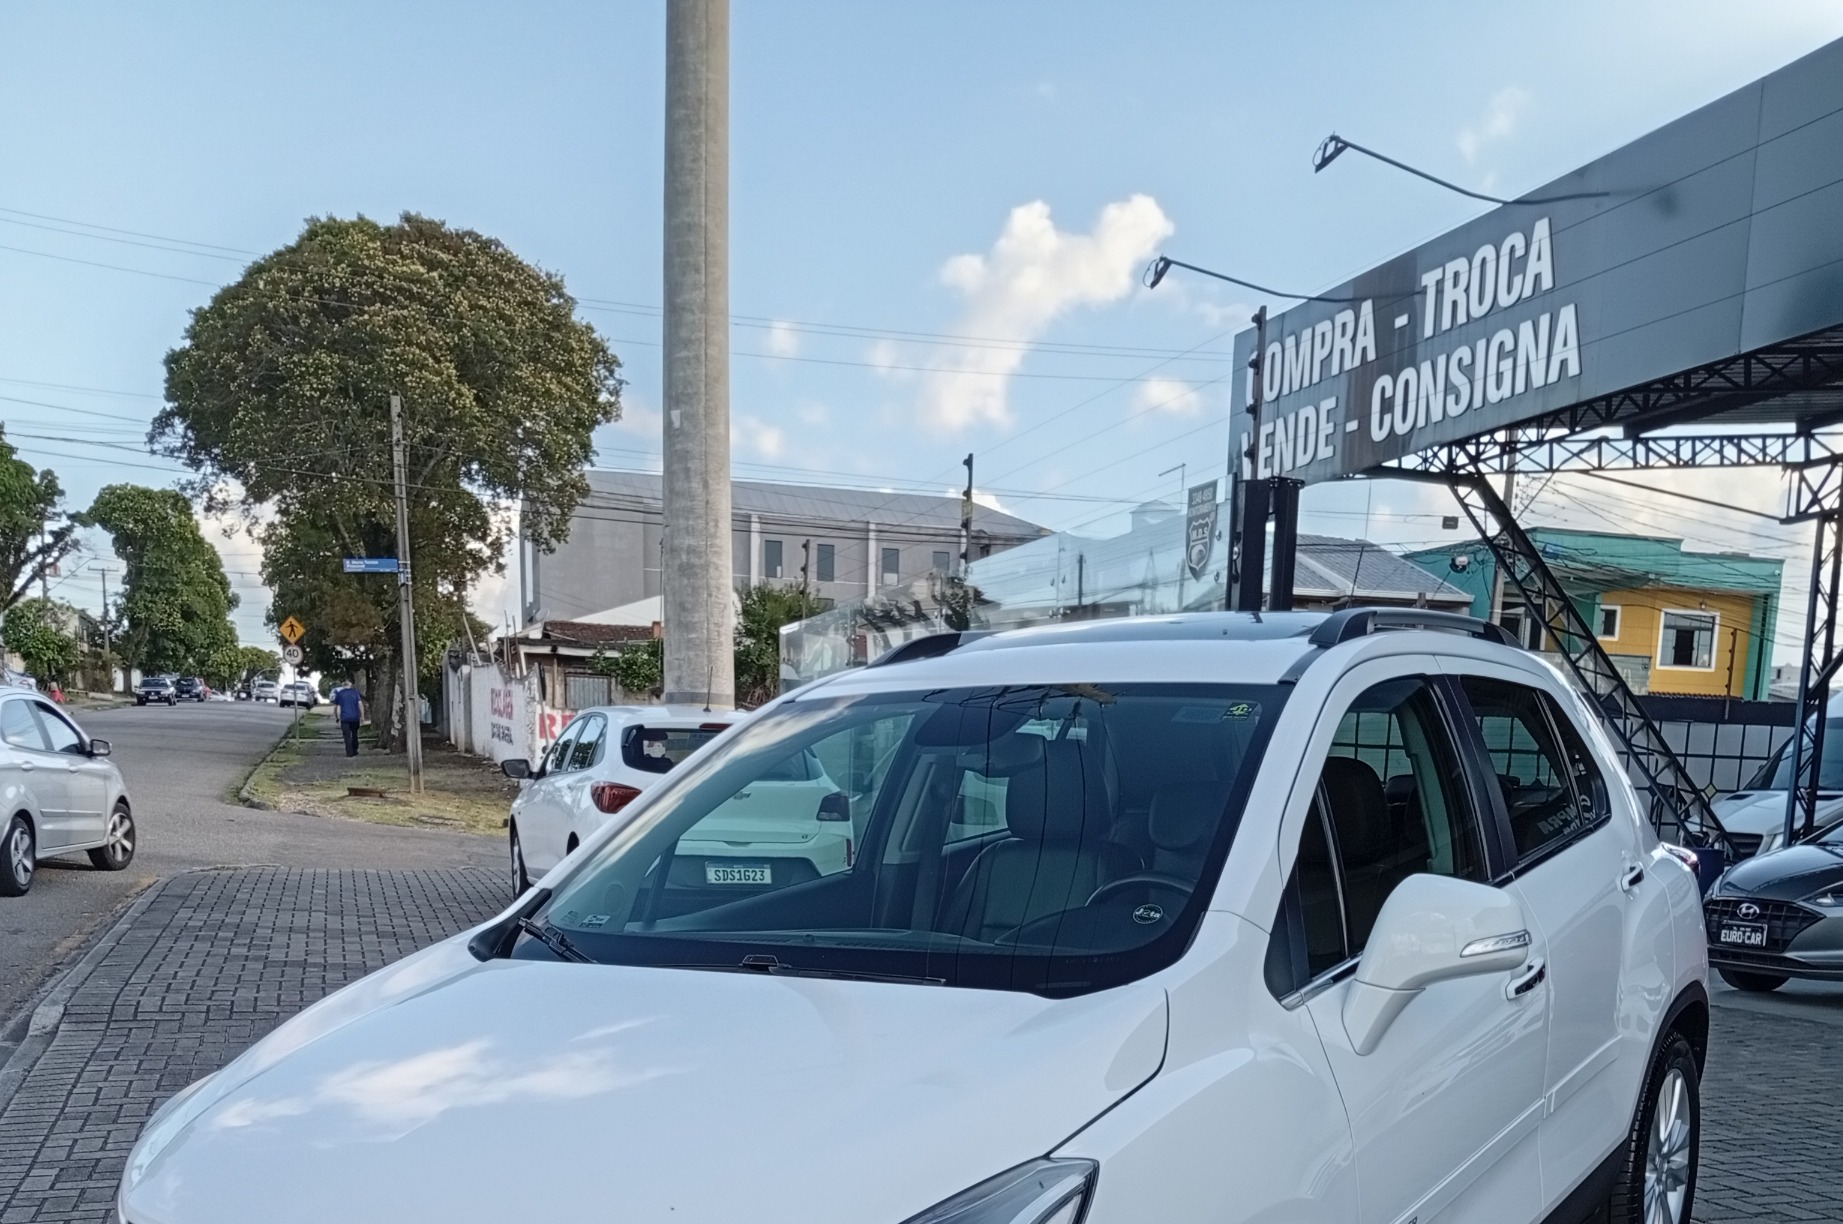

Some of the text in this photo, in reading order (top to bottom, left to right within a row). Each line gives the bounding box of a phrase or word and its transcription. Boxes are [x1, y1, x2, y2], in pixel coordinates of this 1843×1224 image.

[1421, 216, 1555, 339] TROCA
[1370, 303, 1583, 443] CONSIGNA
[286, 649, 299, 658] 40
[714, 869, 765, 881] SDS1G23
